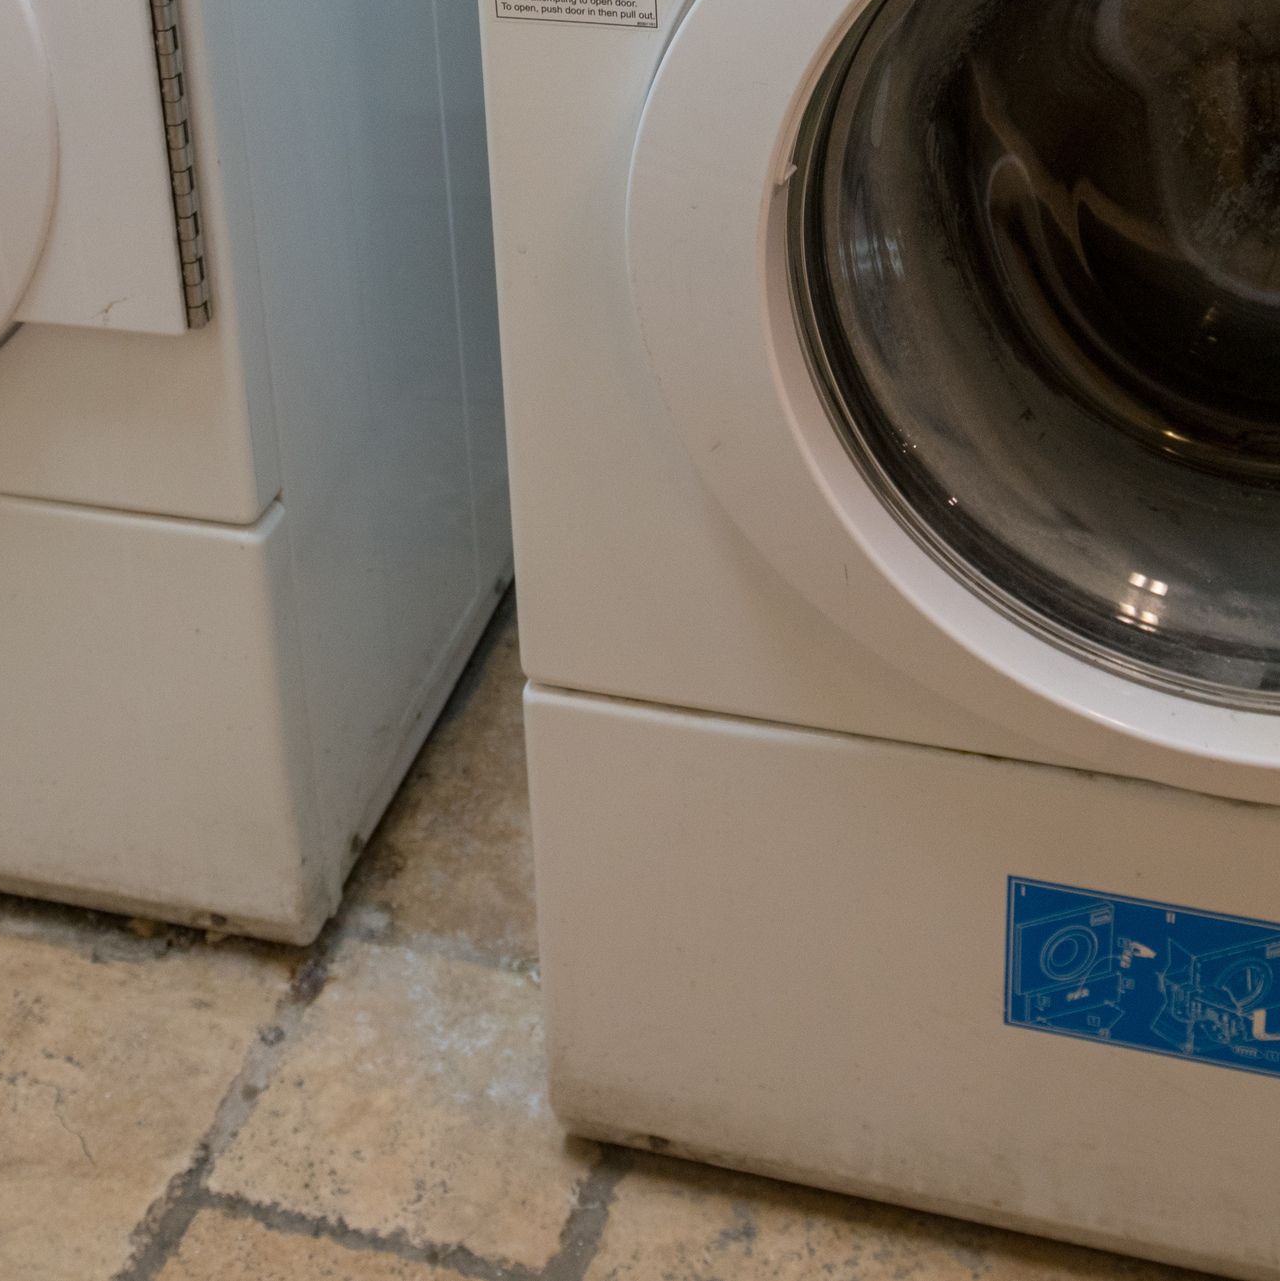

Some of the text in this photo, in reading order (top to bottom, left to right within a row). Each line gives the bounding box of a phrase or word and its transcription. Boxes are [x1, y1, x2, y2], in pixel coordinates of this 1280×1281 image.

[500, 1, 656, 20] To open, push door in then pull out.
